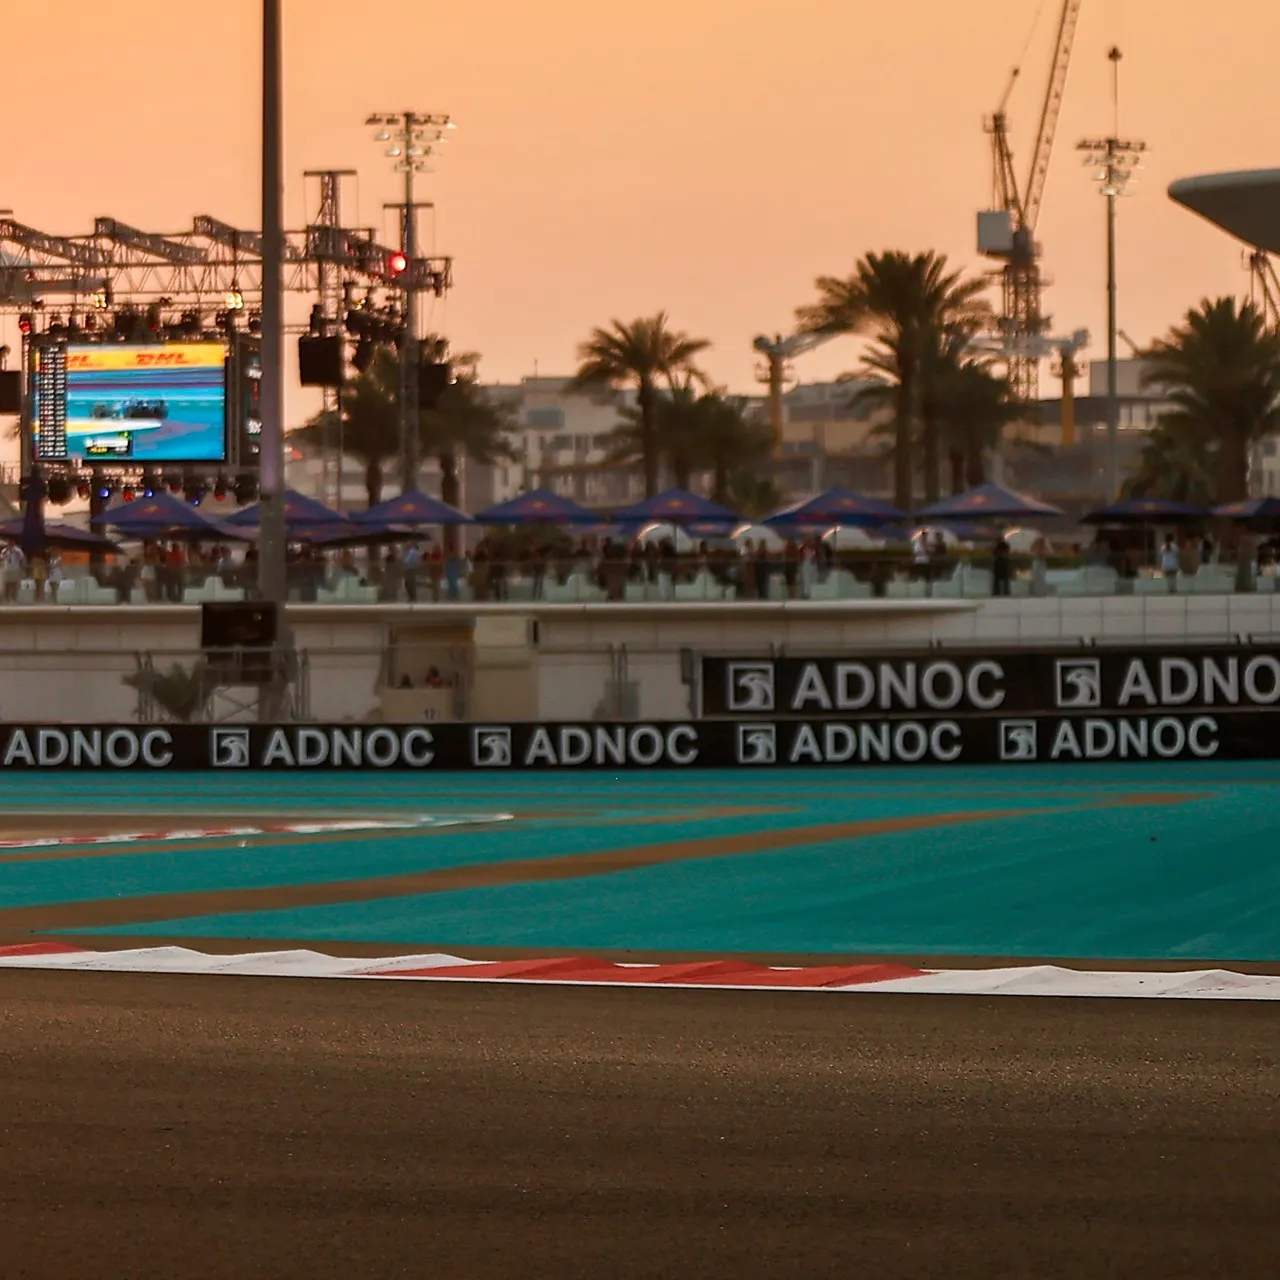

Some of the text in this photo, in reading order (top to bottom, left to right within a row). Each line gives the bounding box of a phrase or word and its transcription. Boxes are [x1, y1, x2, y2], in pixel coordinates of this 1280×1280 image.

[135, 353, 189, 365] DHL
[792, 656, 1280, 710] ADNOC ADNO
[3, 729, 173, 767] ADNOC
[263, 728, 434, 767] ADNOC
[525, 726, 698, 765] ADNOC
[790, 723, 962, 762] ADNOC
[1051, 720, 1219, 758] ADNOC
